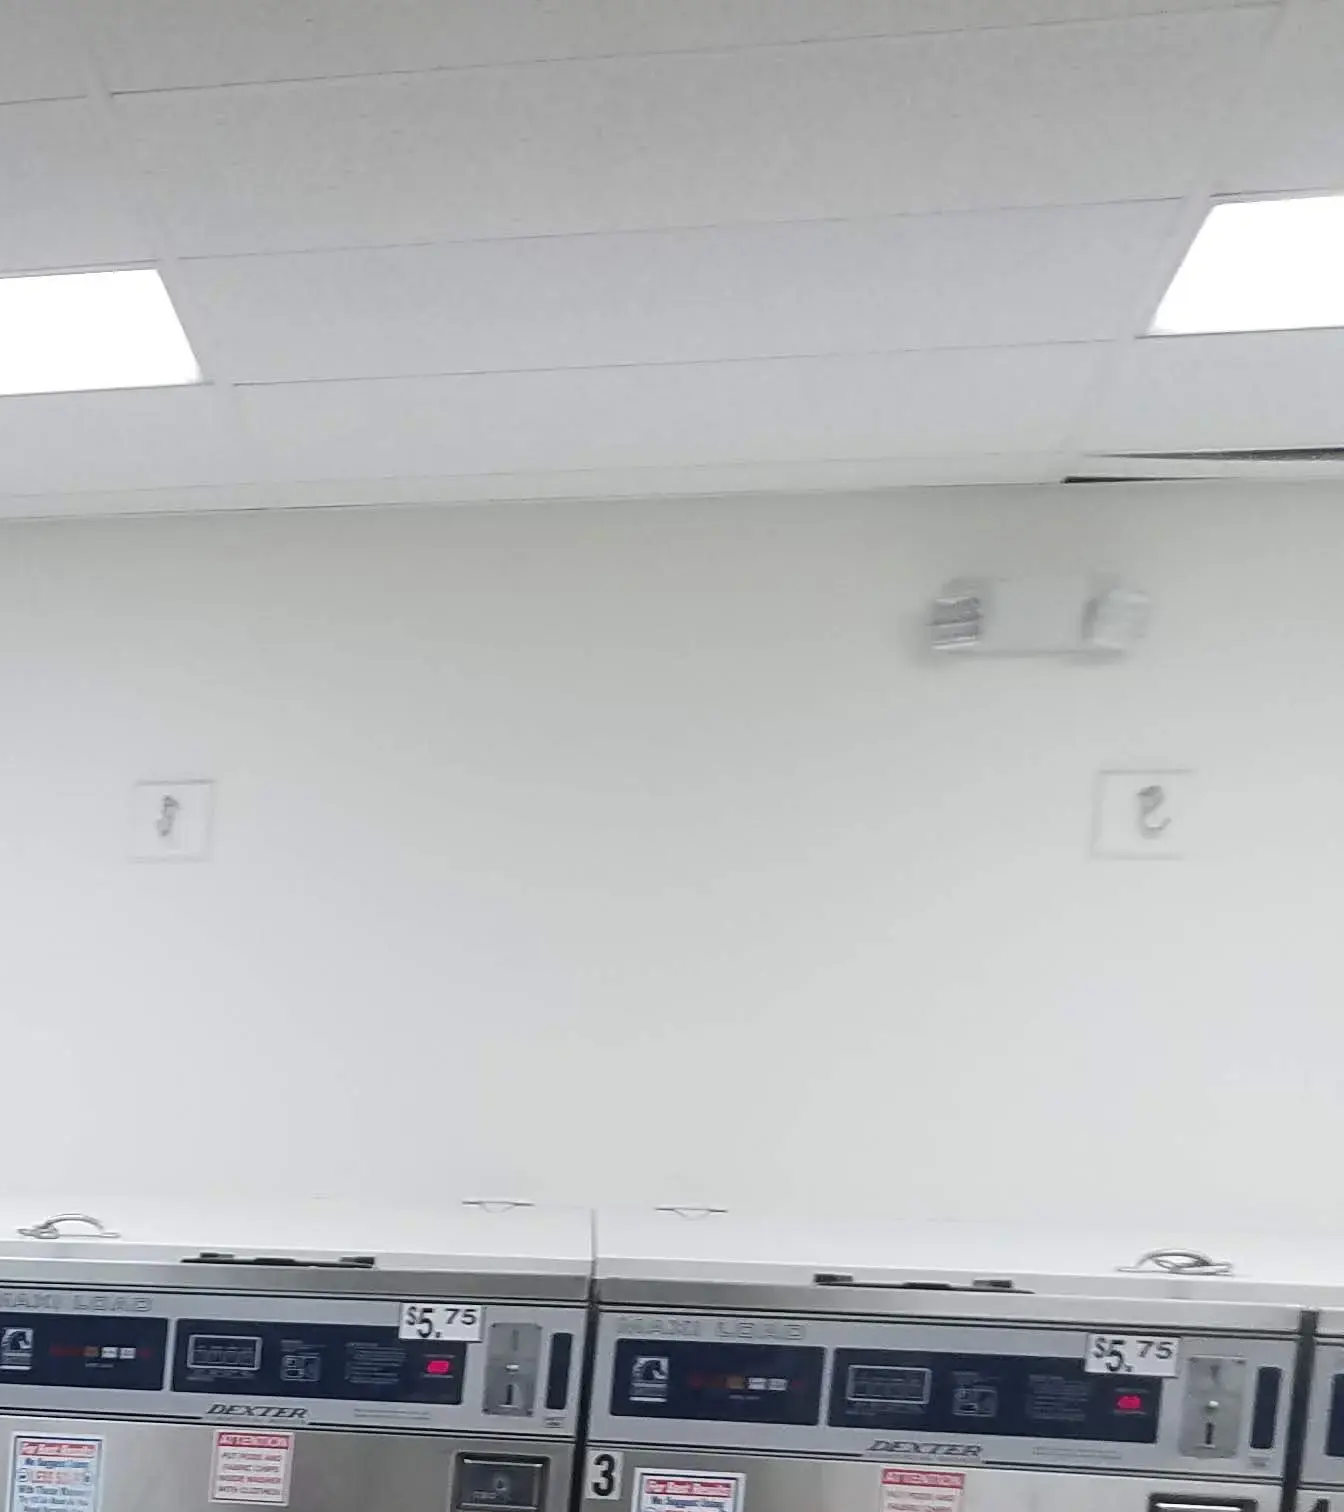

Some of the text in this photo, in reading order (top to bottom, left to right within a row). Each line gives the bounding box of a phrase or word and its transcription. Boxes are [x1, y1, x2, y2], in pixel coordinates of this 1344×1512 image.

[207, 1403, 309, 1419] DEXTER
[865, 1439, 984, 1457] DEXTER
[593, 1454, 616, 1497] 3
